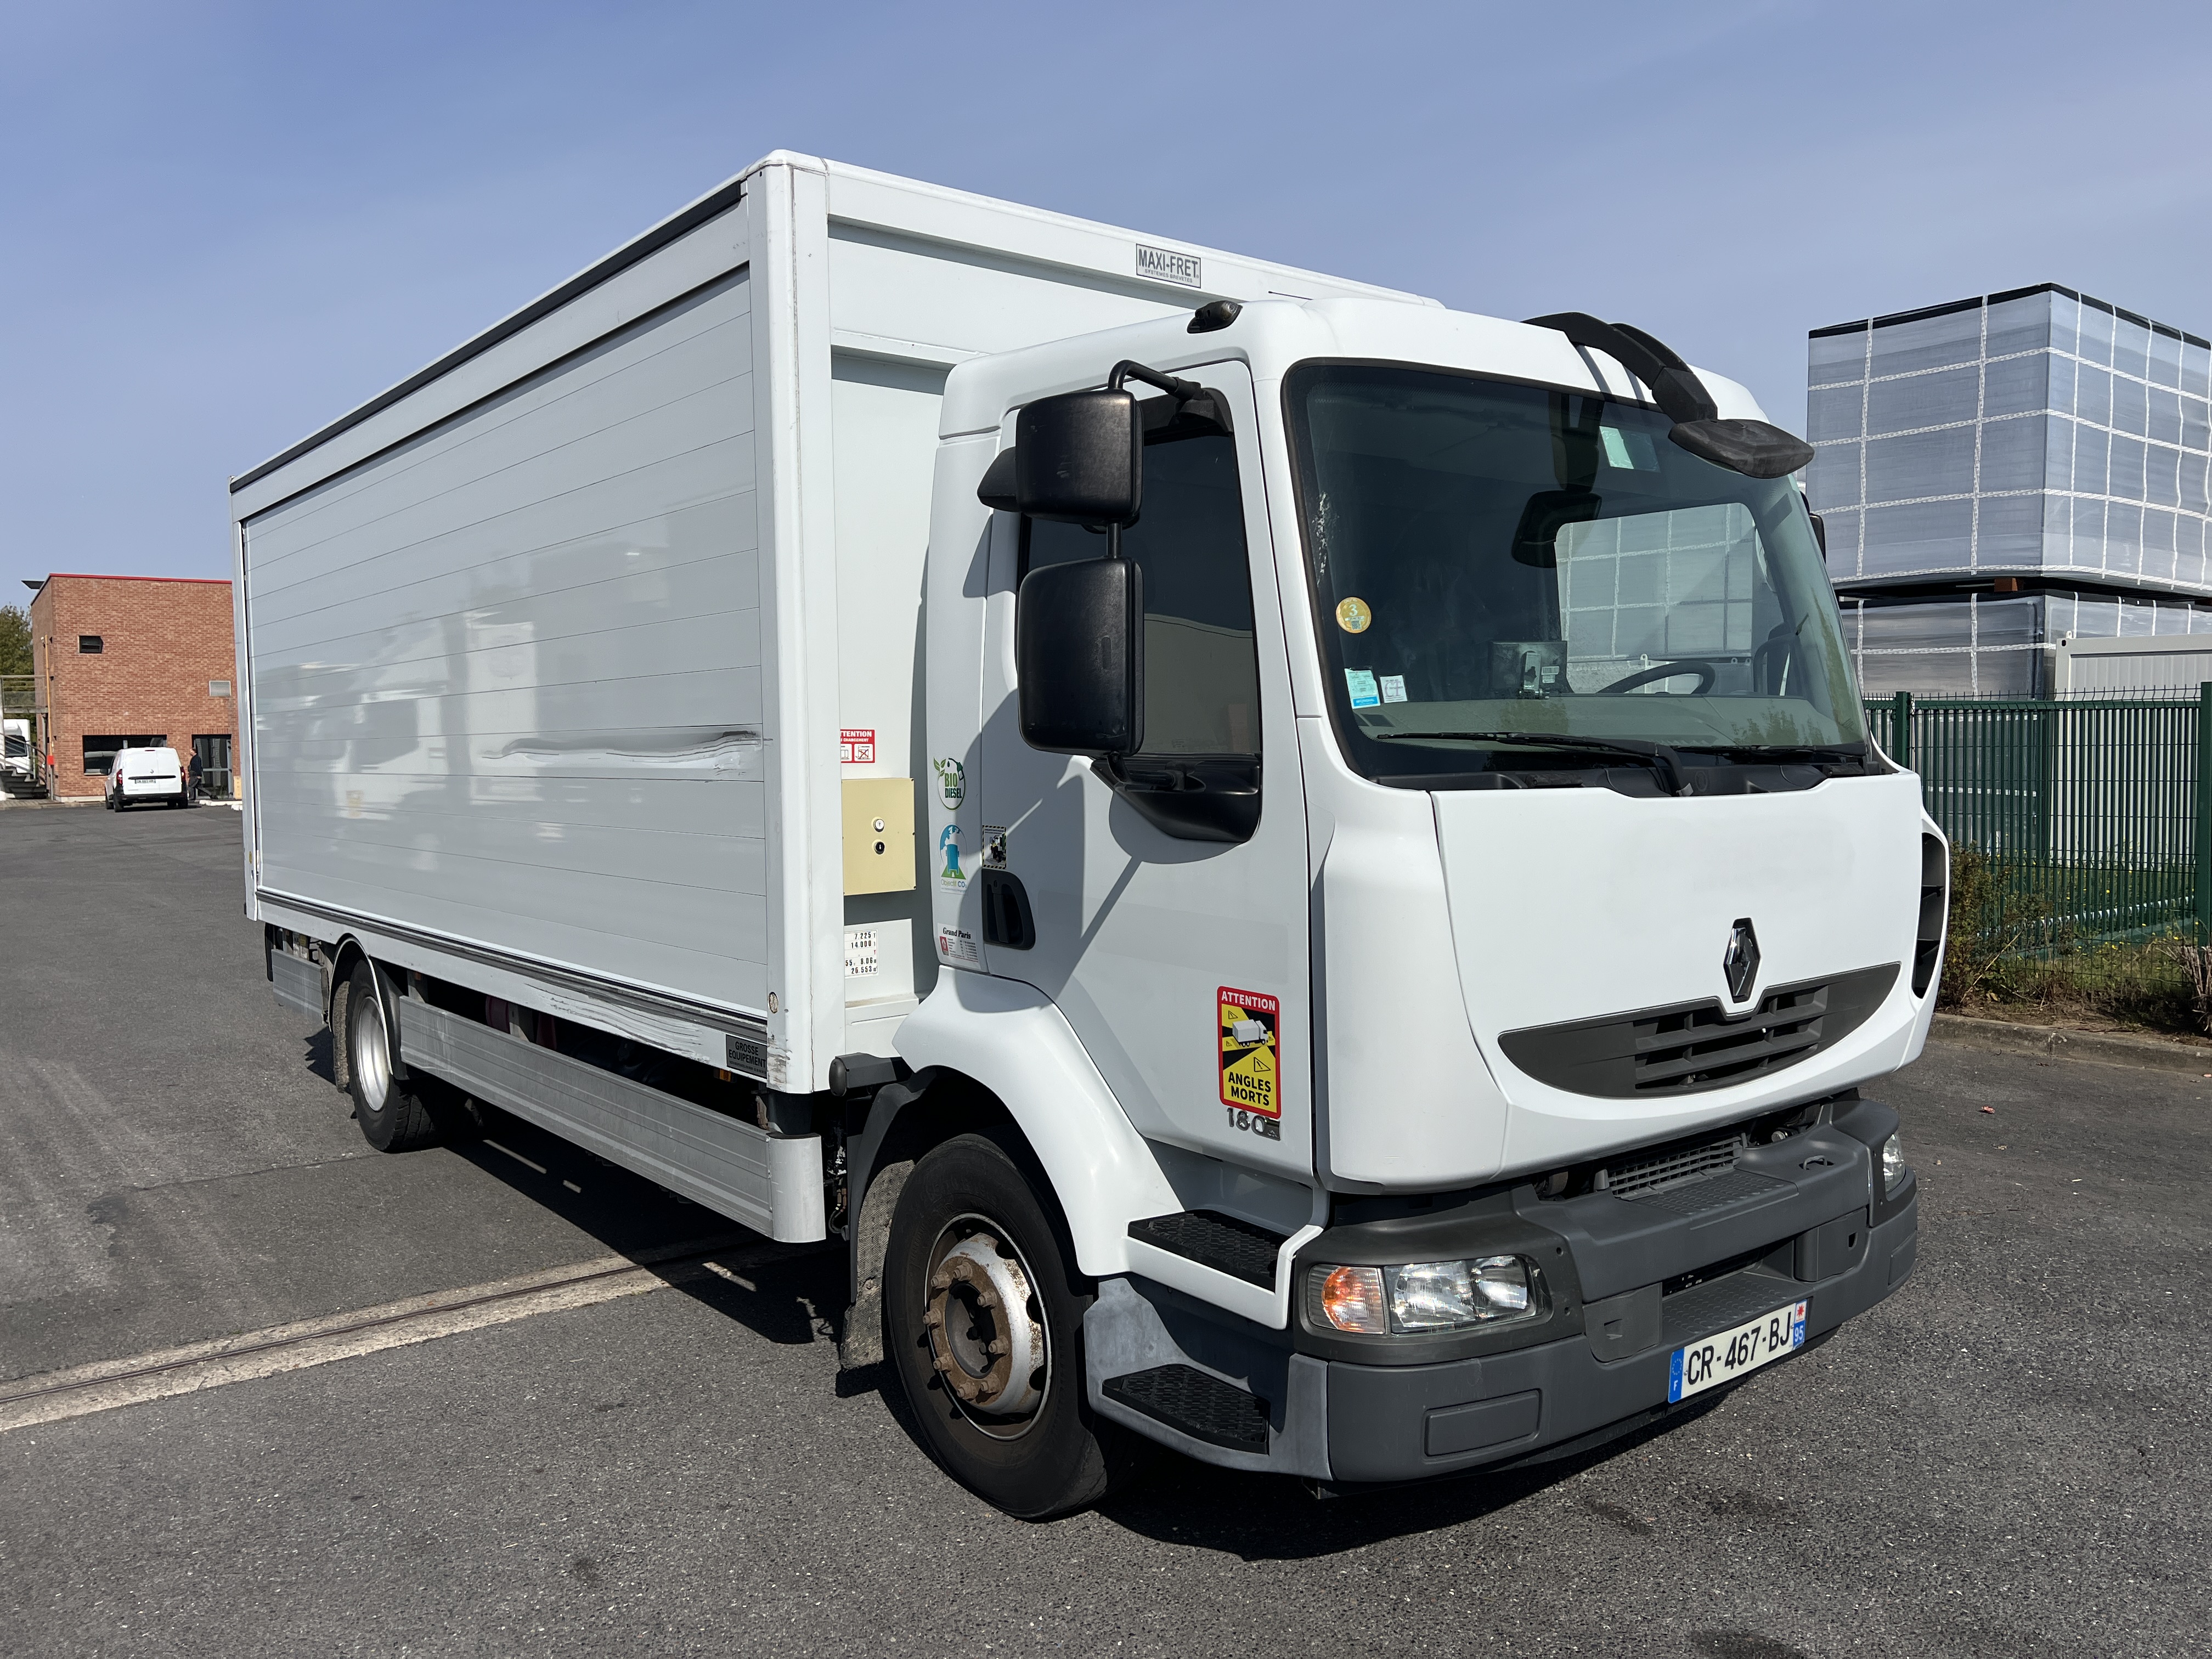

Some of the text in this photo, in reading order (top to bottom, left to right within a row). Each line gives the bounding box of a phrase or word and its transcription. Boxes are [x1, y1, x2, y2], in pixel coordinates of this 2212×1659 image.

[1349, 603, 1358, 617] 3
[945, 772, 957, 787] BIO
[945, 788, 962, 798] DIESEL
[943, 927, 971, 939] Grand Paris
[1221, 991, 1276, 1011] ATTENTION
[736, 1041, 759, 1056] GROSSE
[729, 1049, 766, 1068] EQUIPEMENT
[1228, 1071, 1271, 1092] ANGLES
[1231, 1086, 1269, 1106] MORTS
[1674, 1312, 1804, 1391] F CR-467-BJ 95
